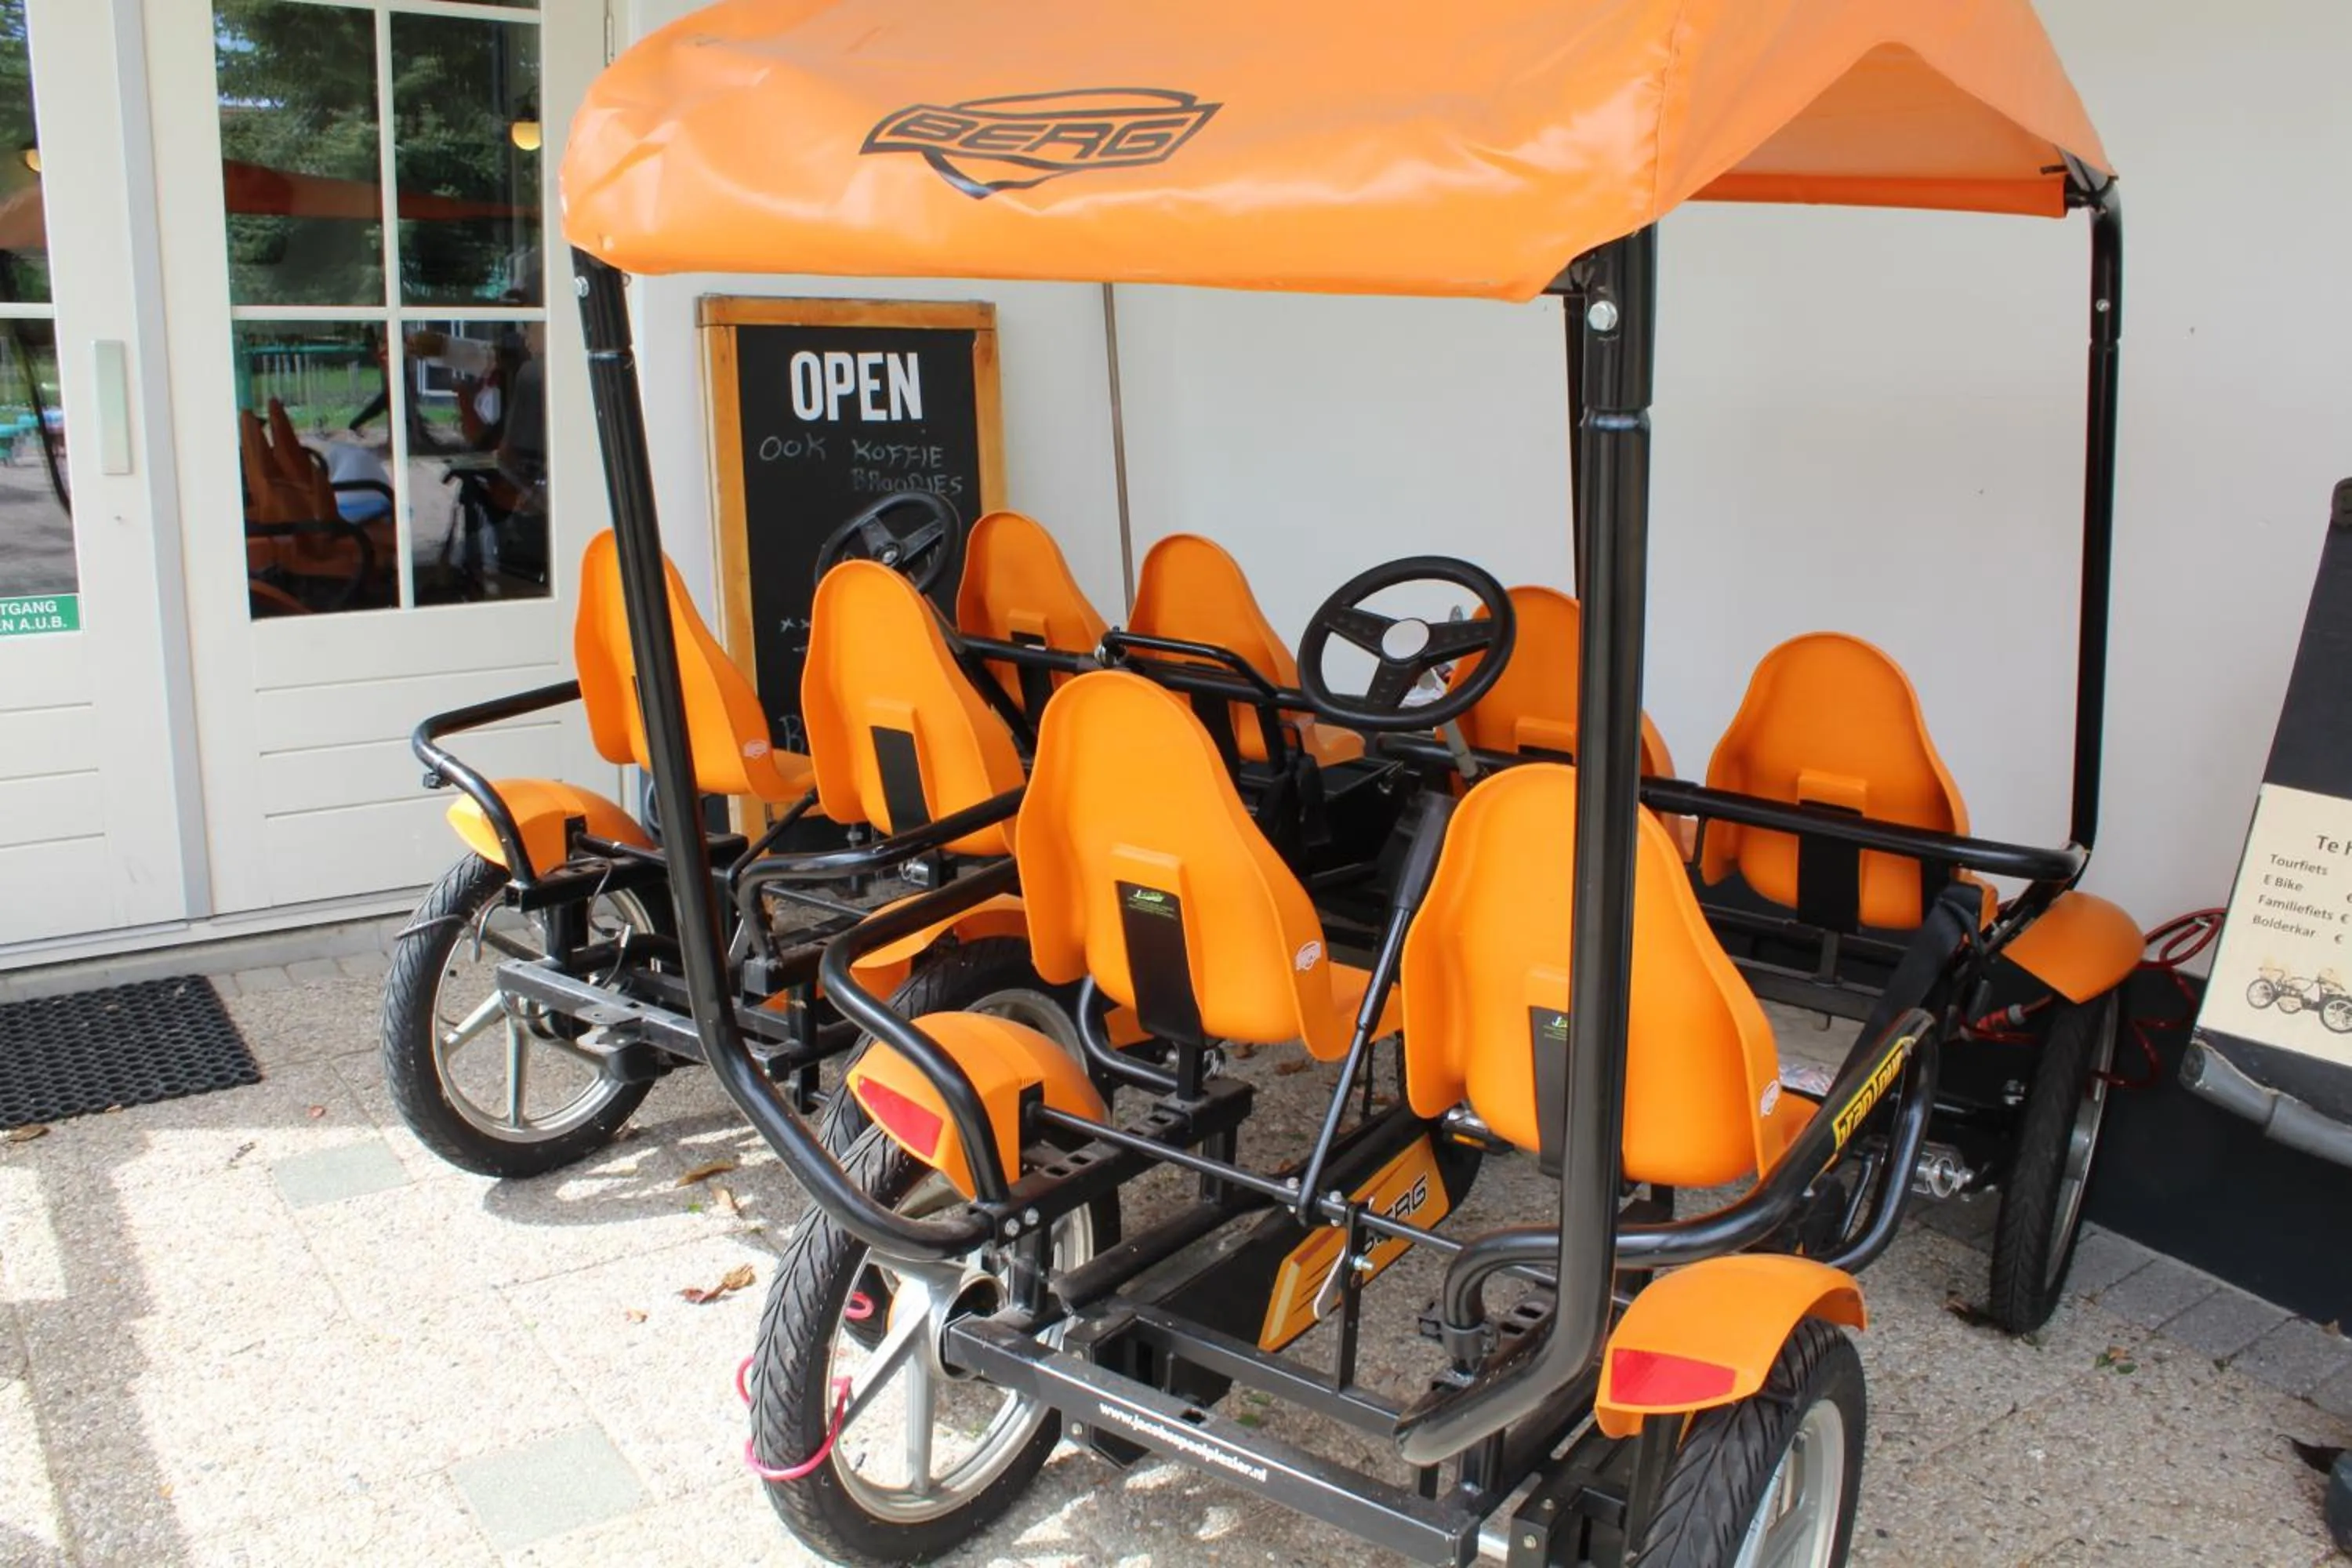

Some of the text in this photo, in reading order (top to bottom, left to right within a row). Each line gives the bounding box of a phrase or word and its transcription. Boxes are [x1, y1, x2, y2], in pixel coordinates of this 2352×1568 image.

[887, 112, 1191, 159] BERG
[790, 351, 923, 421] OPEN
[20, 615, 67, 630] A.U.B.
[2316, 834, 2339, 854] Te
[2270, 853, 2328, 877] Tourfiets
[2274, 877, 2303, 892] Bike
[2258, 895, 2333, 921] Familiefiets
[2252, 914, 2316, 938] Bolderkar
